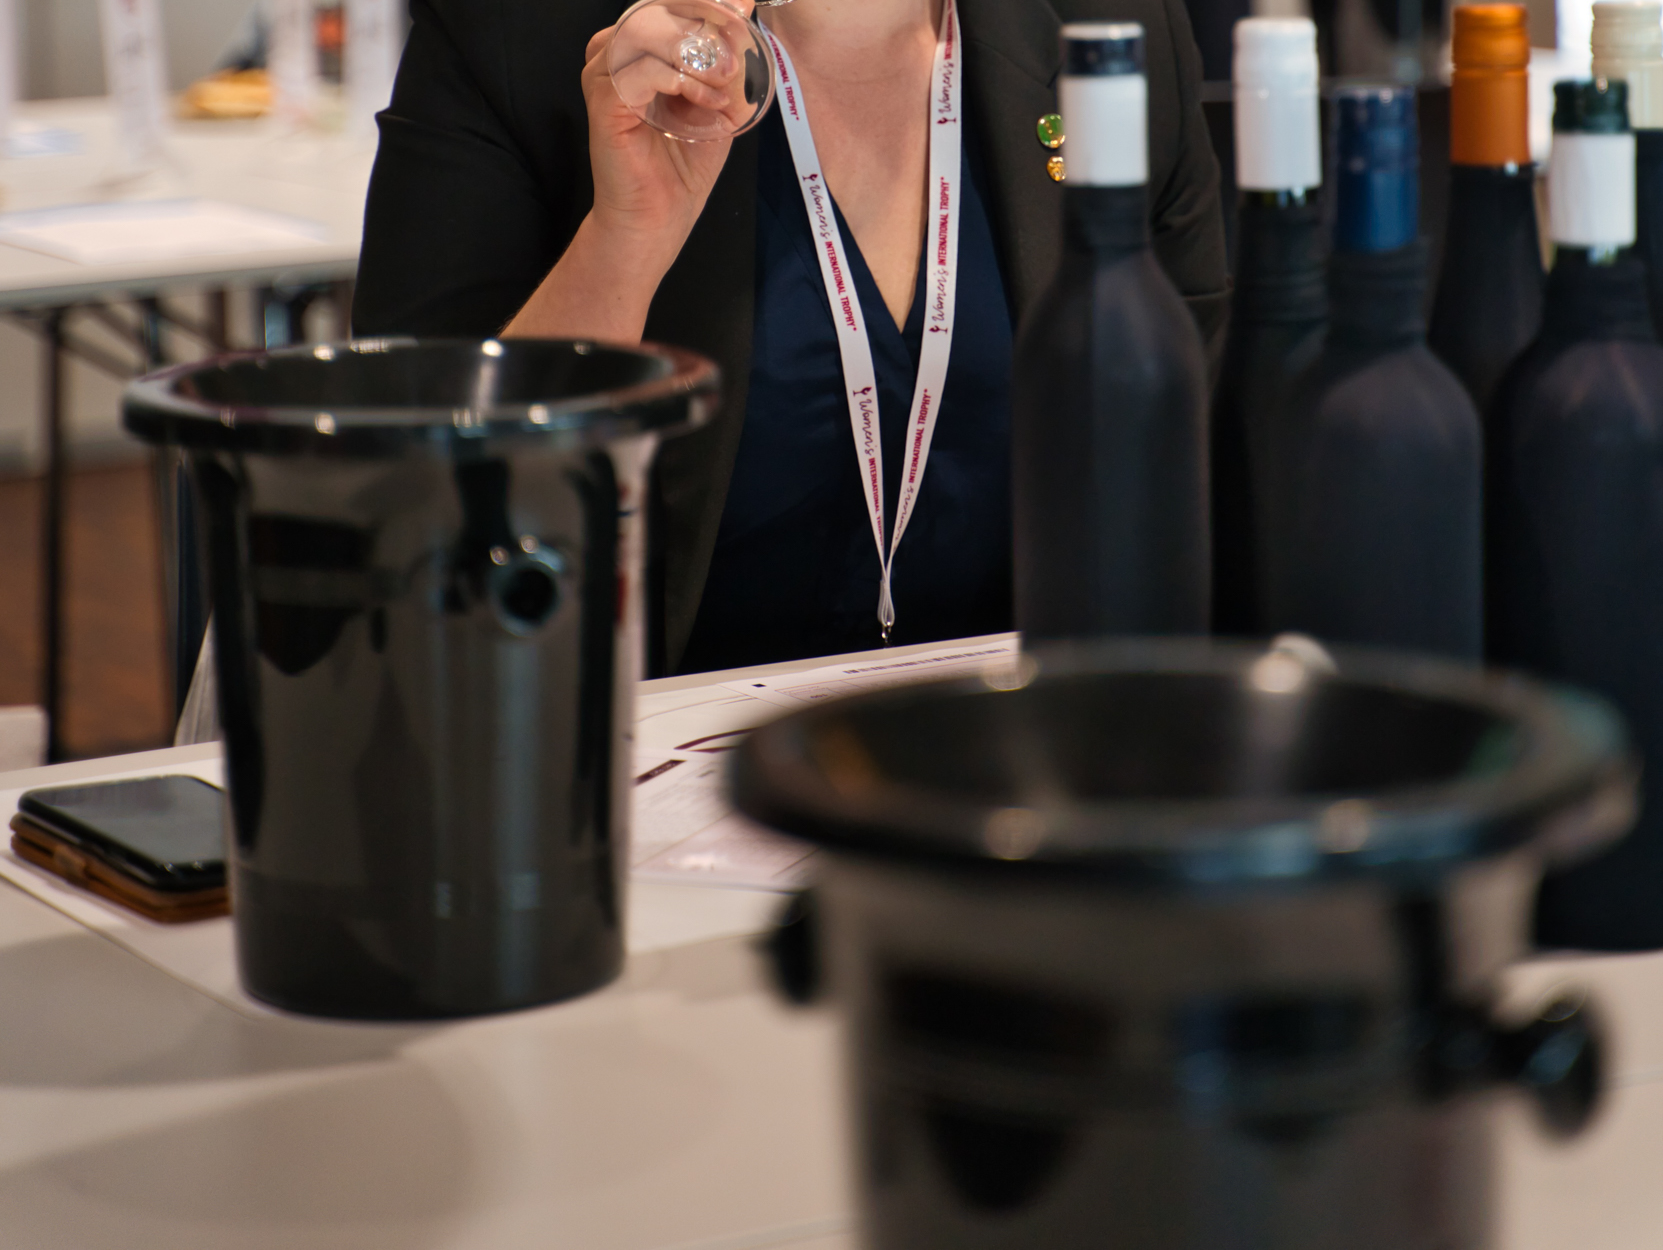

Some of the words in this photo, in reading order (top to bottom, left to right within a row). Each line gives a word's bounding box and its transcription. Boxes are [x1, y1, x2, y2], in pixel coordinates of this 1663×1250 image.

[938, 63, 954, 114] Women's
[809, 184, 833, 239] Women's
[825, 241, 846, 295] INTERNATIONAL
[937, 213, 949, 266] INTERNATIONAL
[932, 268, 949, 323] Women's
[859, 398, 877, 456] Women's
[868, 457, 880, 512] INTERNATIONAL
[908, 427, 925, 484] INTERNATIONAL
